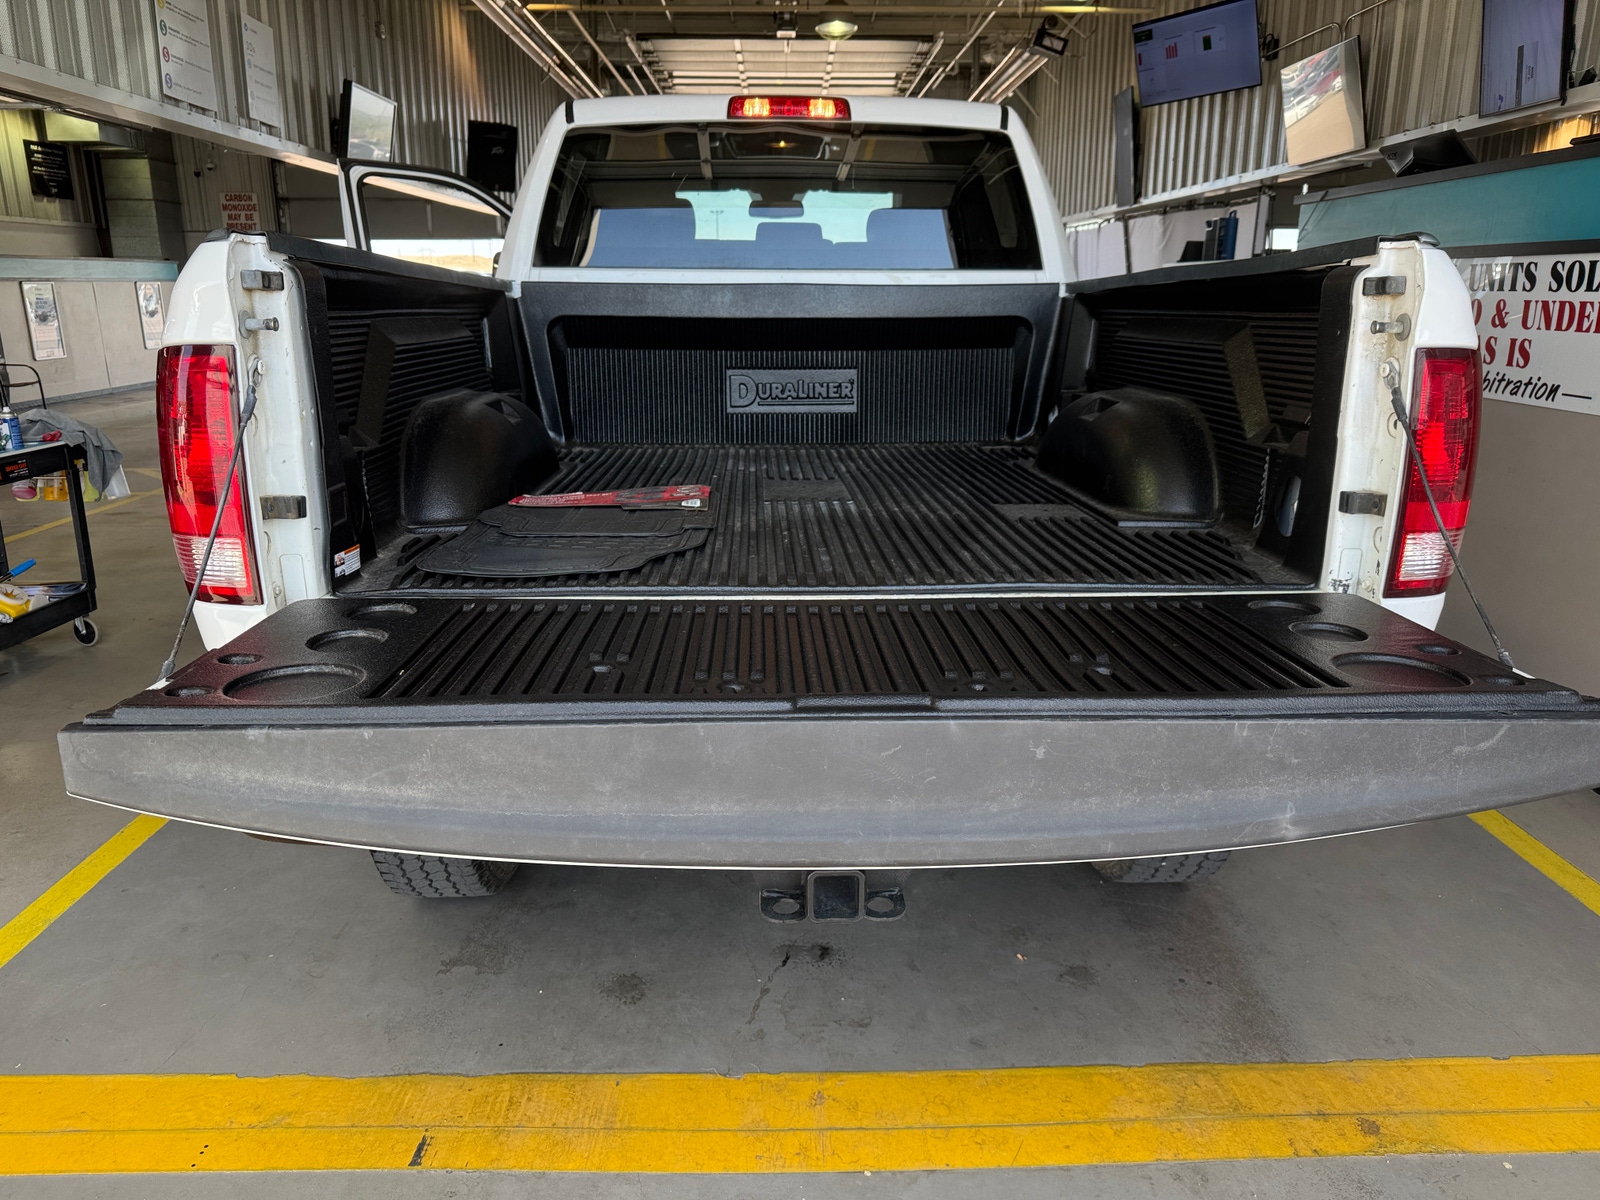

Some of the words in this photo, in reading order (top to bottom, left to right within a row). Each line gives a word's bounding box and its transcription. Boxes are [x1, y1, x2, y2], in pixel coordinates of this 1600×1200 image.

[221, 203, 258, 212] MONOXIDE
[224, 193, 253, 202] CARBON
[226, 222, 257, 231] PRESENT
[227, 213, 241, 221] MAY
[244, 213, 255, 221] BE
[1468, 261, 1539, 293] UNITS
[1490, 298, 1510, 329] &
[1505, 337, 1532, 369] IS
[729, 375, 854, 408] DURALINER
